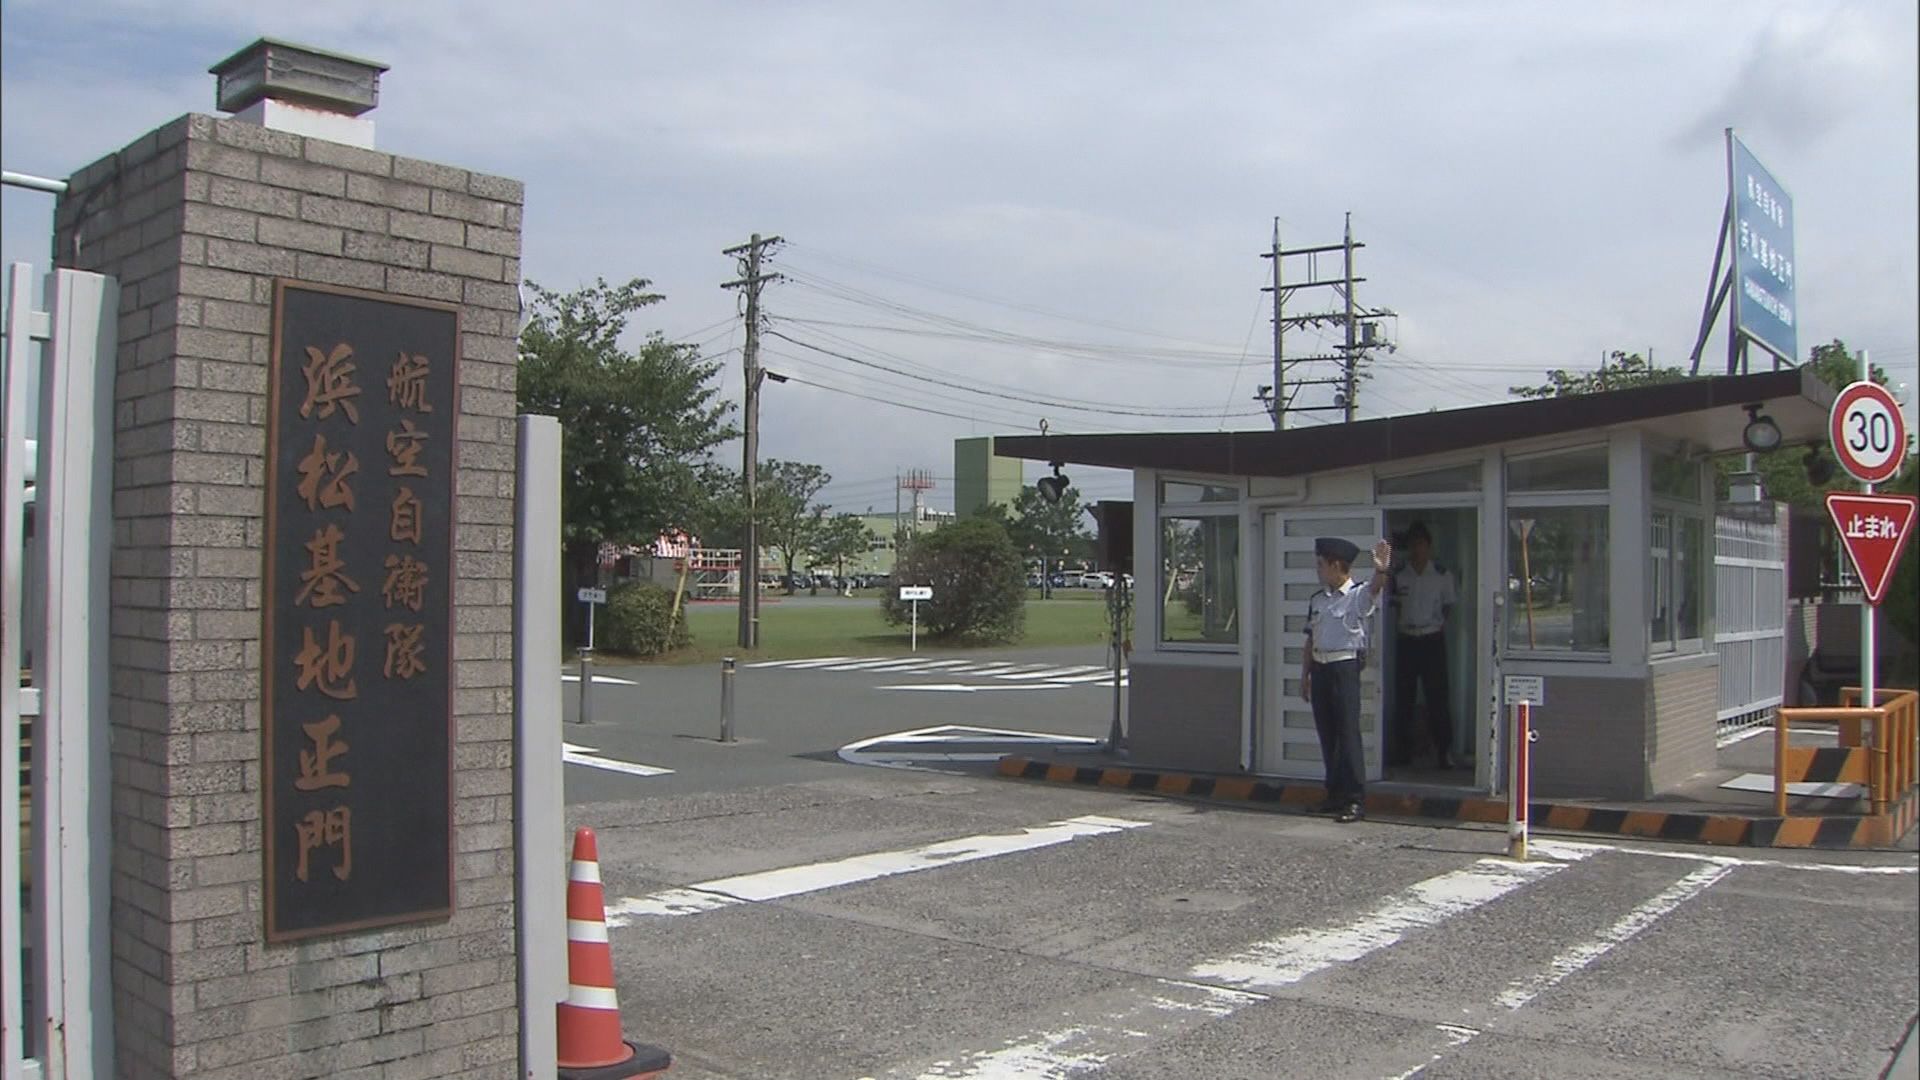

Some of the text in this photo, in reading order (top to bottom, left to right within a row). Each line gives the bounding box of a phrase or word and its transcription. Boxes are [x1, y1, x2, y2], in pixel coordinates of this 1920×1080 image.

[382, 351, 432, 679] 航空自衛隊
[1849, 411, 1889, 453] 30
[294, 342, 362, 883] 浜松基地正門
[1846, 513, 1898, 539] 止まれ
